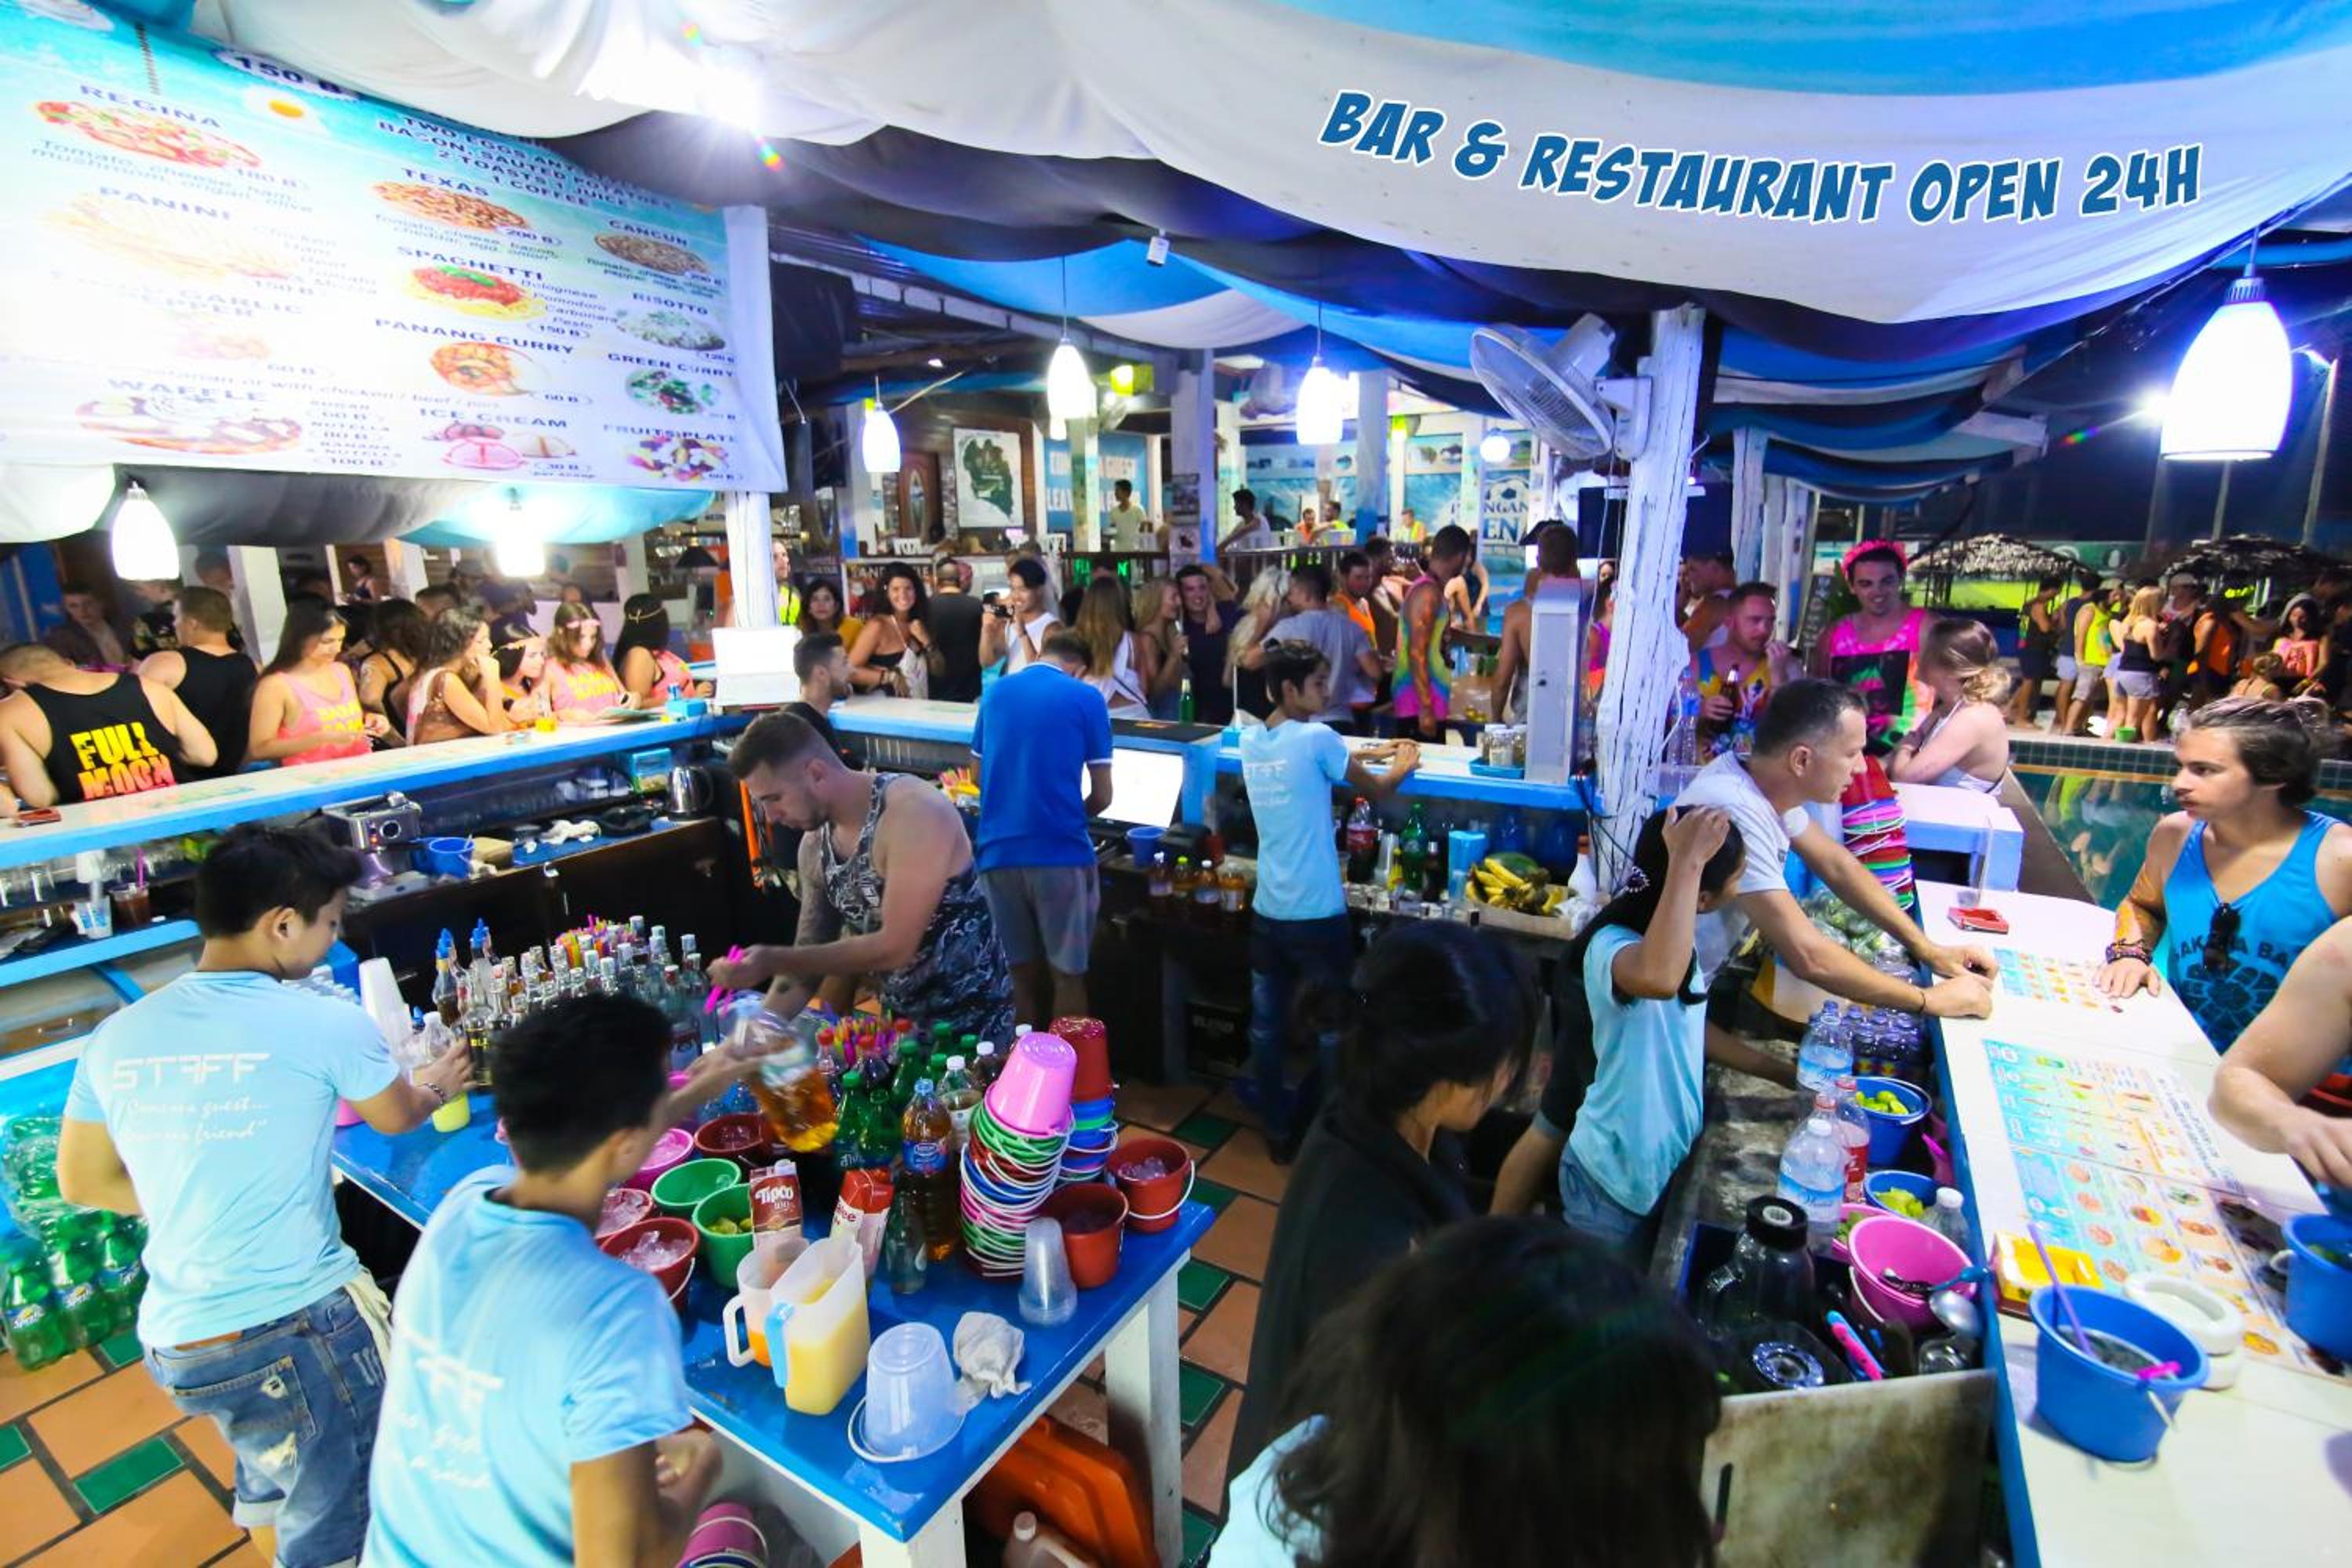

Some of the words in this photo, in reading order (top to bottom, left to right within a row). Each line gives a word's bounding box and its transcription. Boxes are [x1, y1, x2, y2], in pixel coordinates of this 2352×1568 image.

[234, 56, 303, 84] 150
[79, 84, 221, 128] REGINA
[405, 117, 457, 139] TWO
[468, 136, 527, 159] EGGS
[401, 168, 490, 197] TEXAS
[510, 180, 592, 207] COFFEE
[100, 186, 230, 220] PANINI
[608, 219, 688, 247] CANCUN
[397, 245, 543, 281] SPAGHETTI
[376, 318, 486, 342] PANANG
[495, 335, 575, 354] CURRY
[608, 353, 671, 369] GREEN
[677, 363, 734, 378] CURRY
[419, 407, 466, 419] ICE
[477, 413, 567, 429] CREAM
[70, 721, 160, 771] FULL
